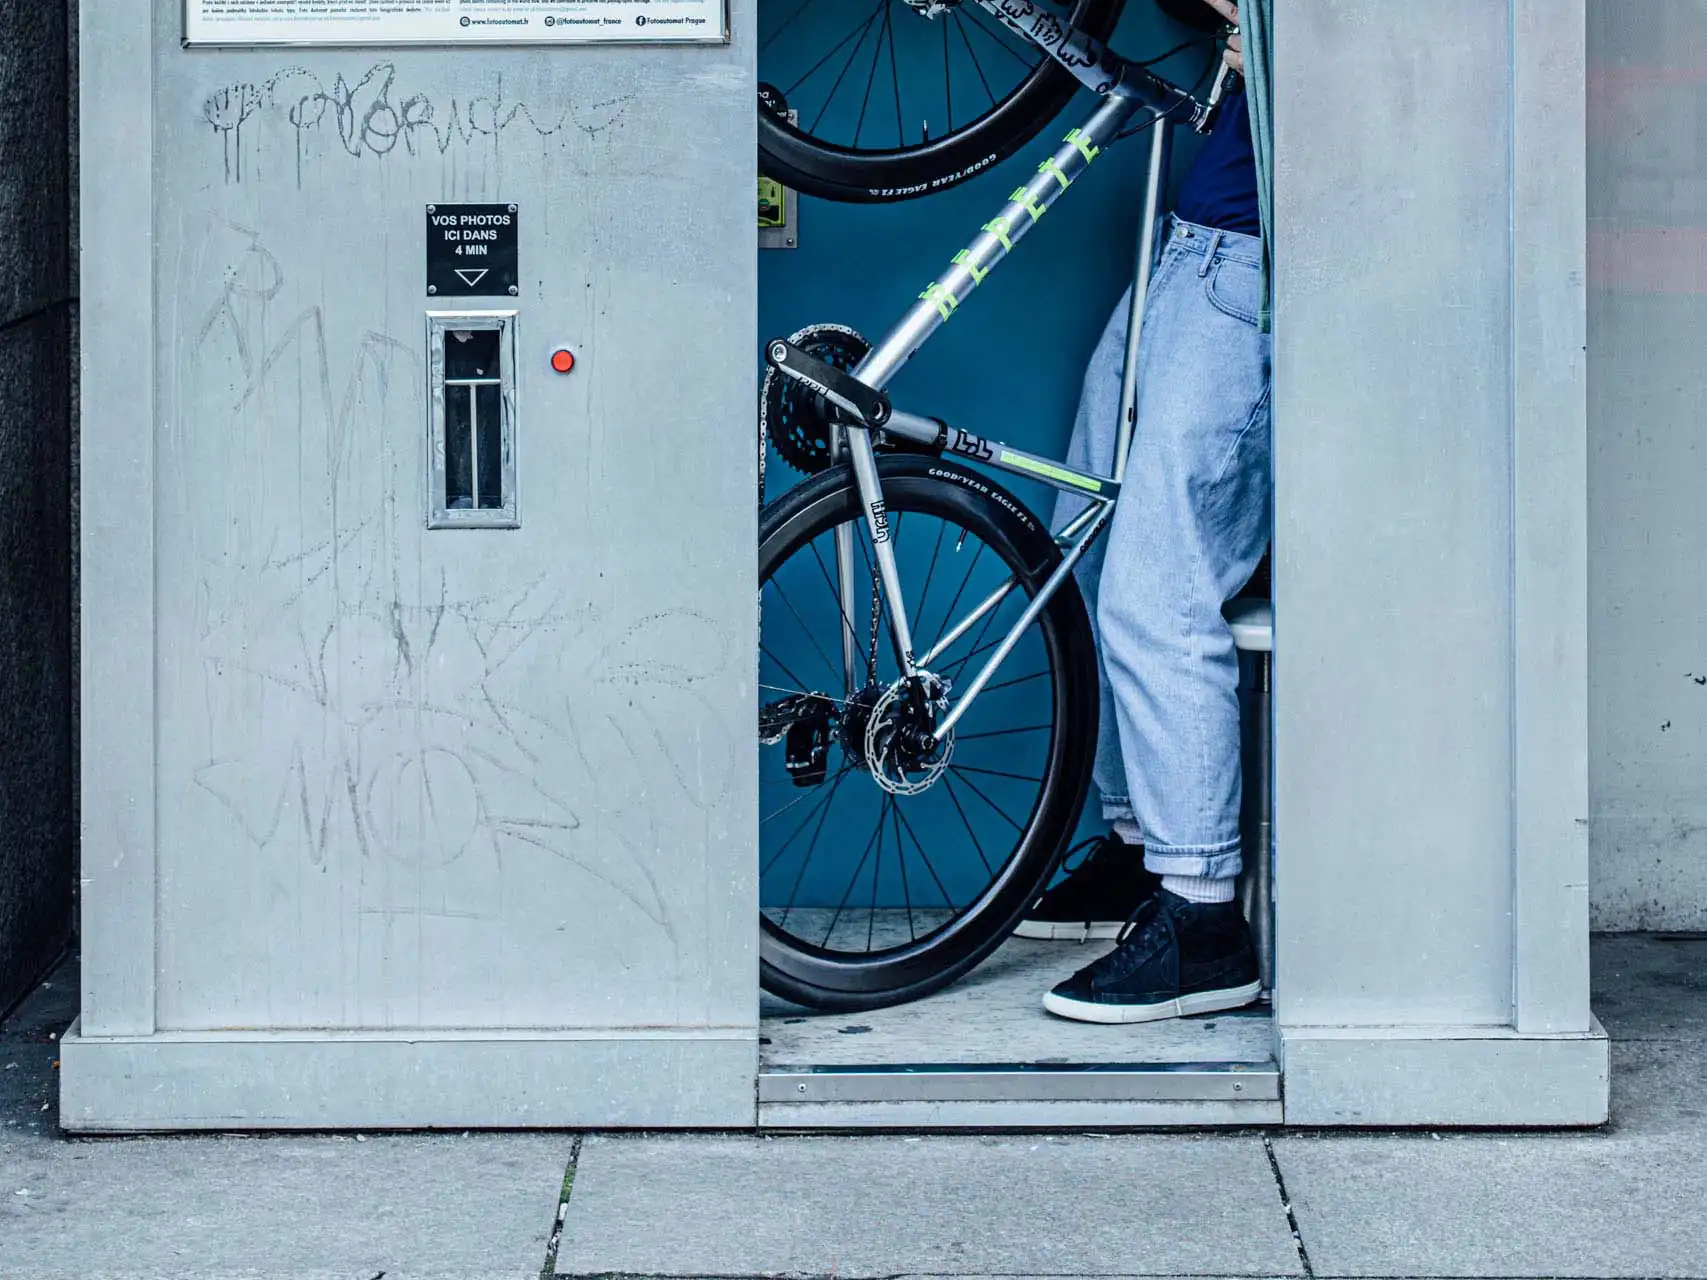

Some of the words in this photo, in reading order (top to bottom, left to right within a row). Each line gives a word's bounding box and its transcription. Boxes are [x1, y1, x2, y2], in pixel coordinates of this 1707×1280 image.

[431, 215, 458, 226] VOS
[460, 214, 511, 226] PHOTOS
[444, 230, 460, 241] ICI
[463, 229, 498, 241] DANS
[454, 244, 463, 256] 4
[465, 244, 488, 256] MIN
[928, 468, 989, 494] GOODYEAR
